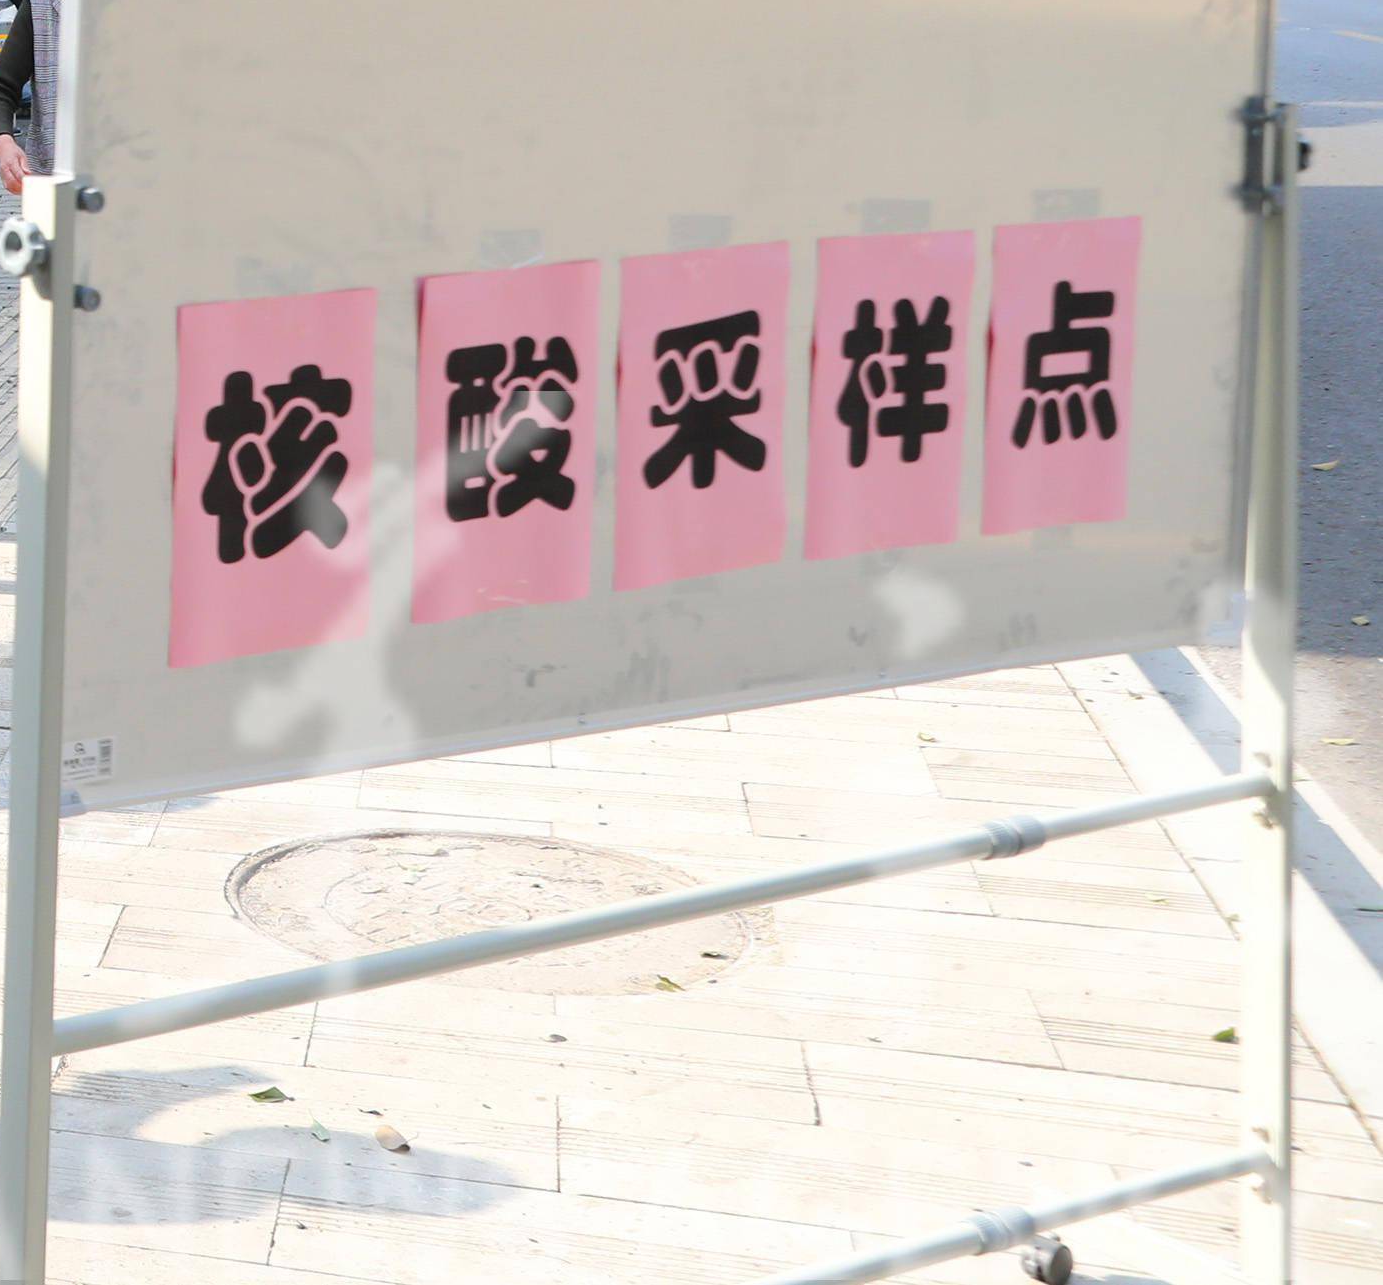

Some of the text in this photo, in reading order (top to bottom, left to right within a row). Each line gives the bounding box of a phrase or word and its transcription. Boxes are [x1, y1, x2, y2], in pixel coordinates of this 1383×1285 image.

[201, 279, 1117, 564] 核酸采样点
